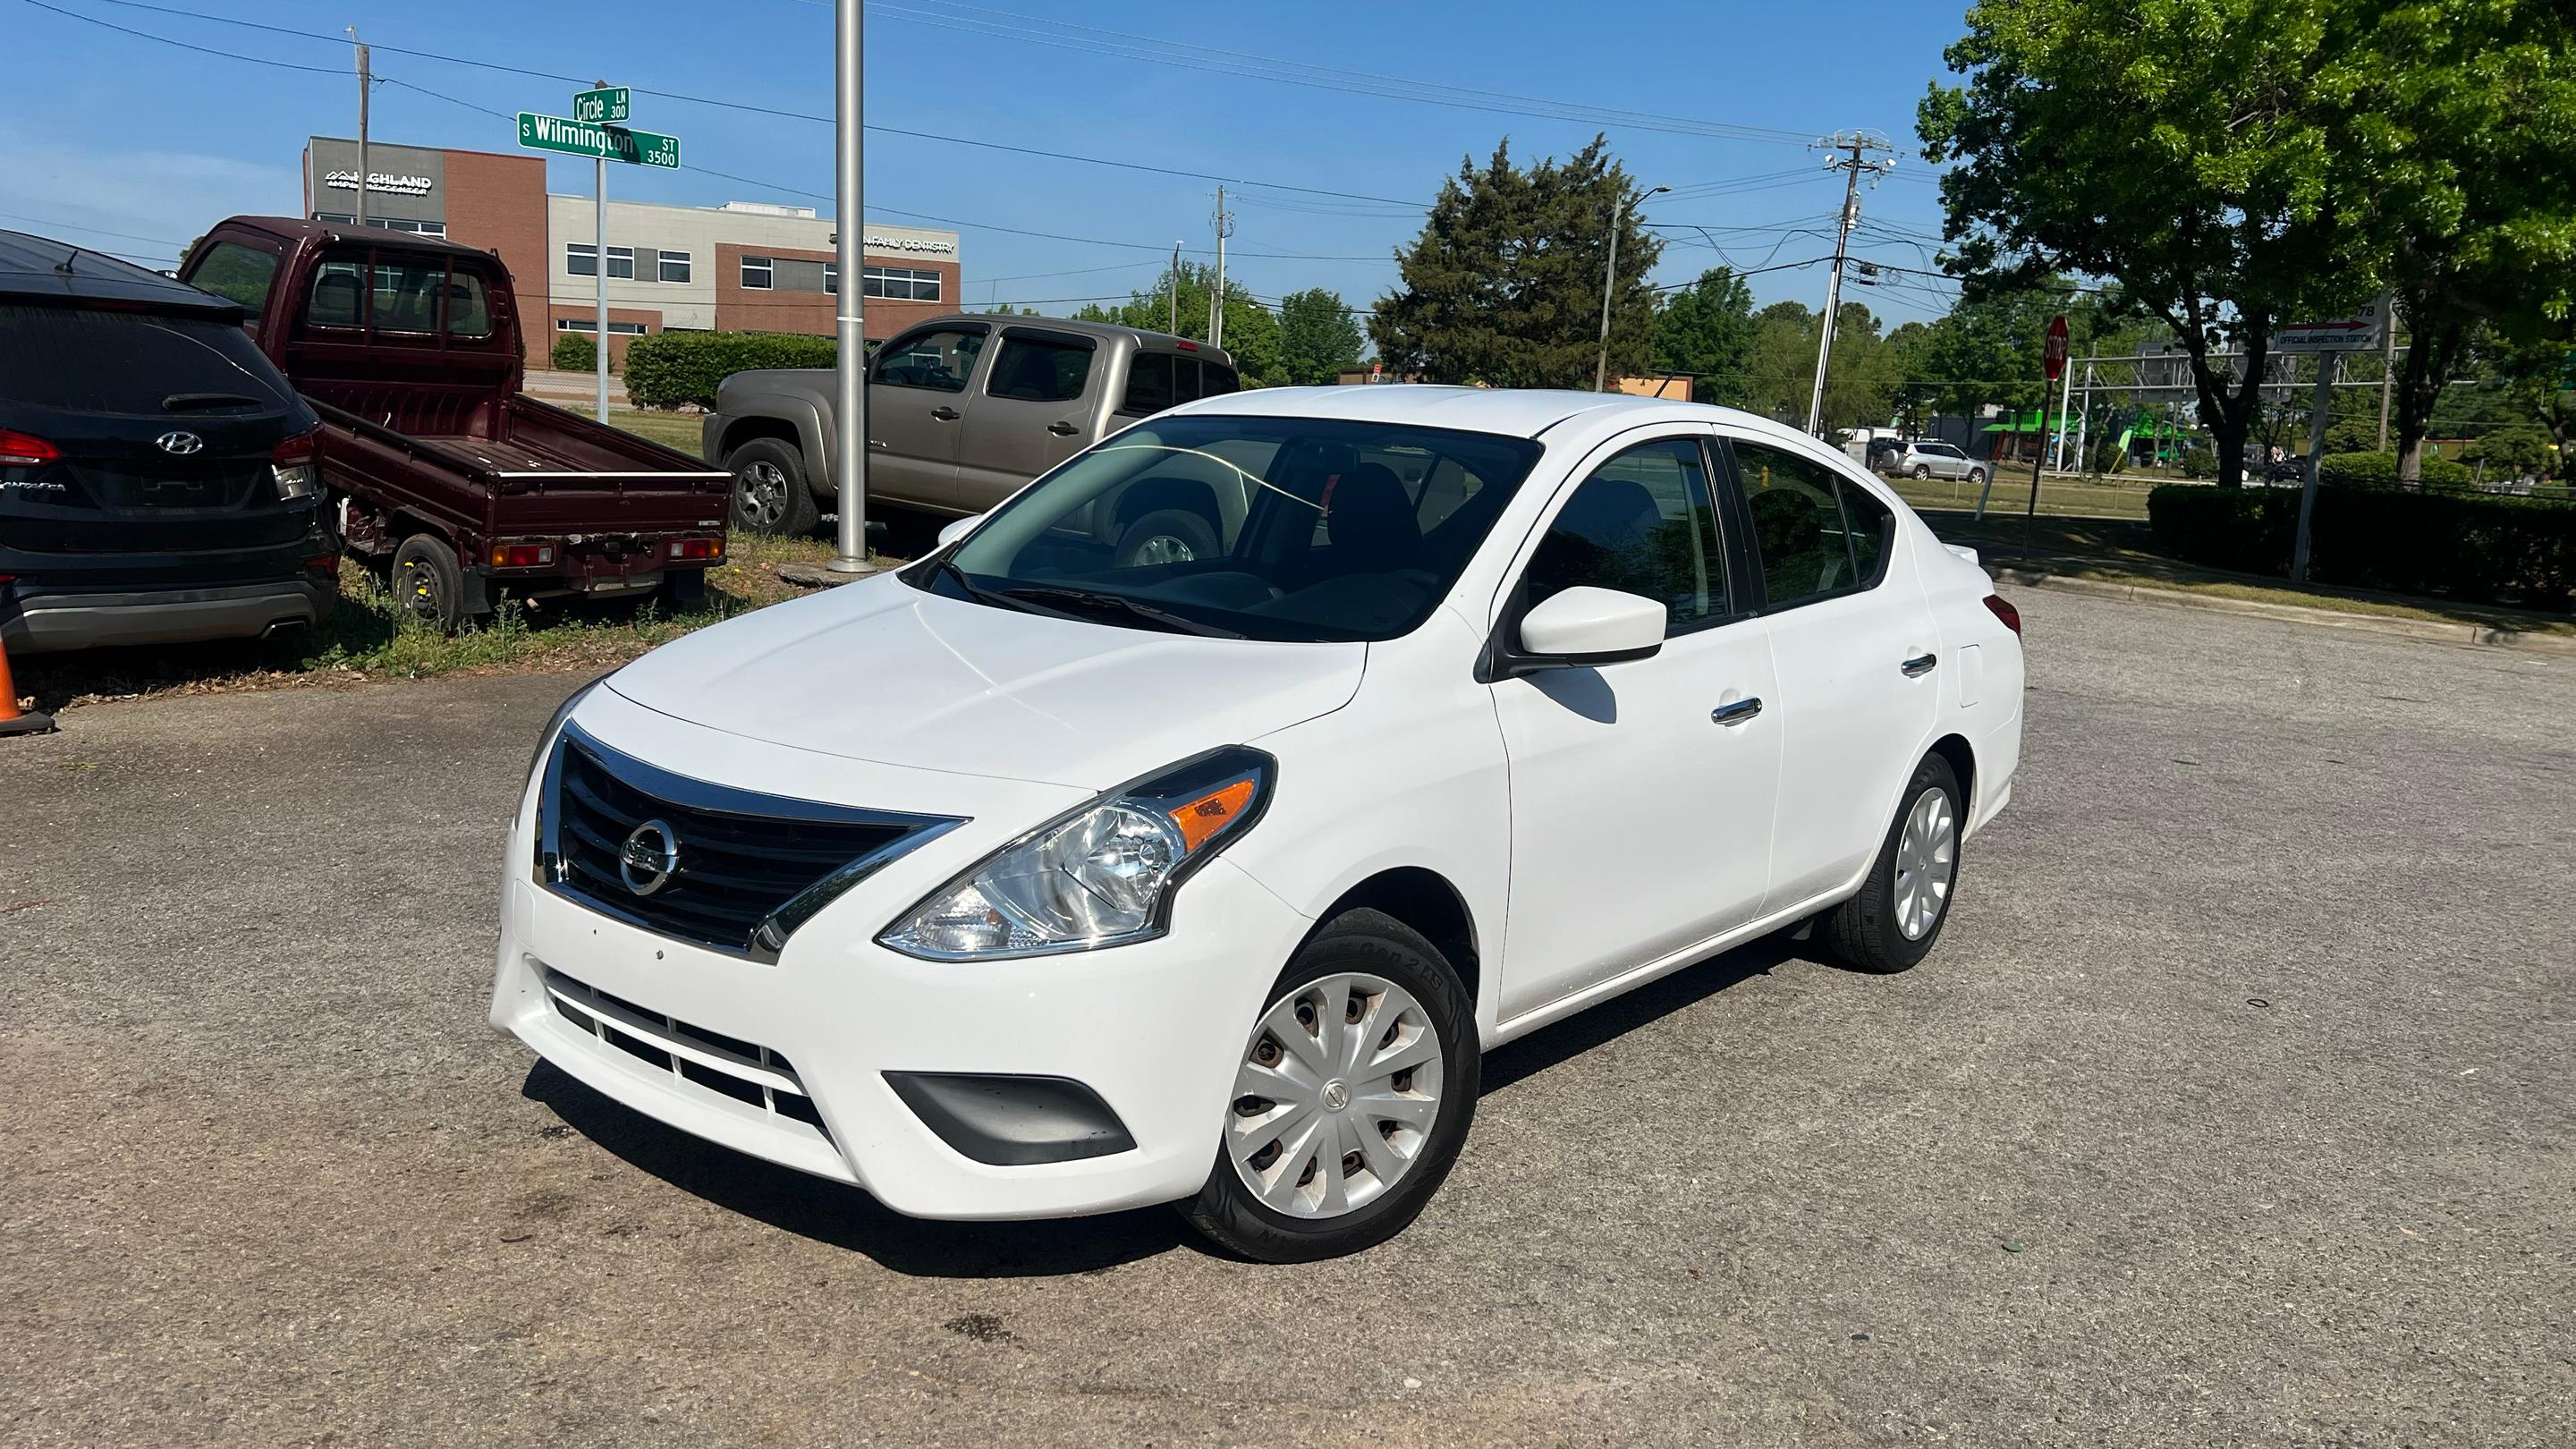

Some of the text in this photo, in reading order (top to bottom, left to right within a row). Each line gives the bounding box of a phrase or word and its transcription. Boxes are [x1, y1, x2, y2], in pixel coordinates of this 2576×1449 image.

[577, 90, 626, 121] Circle LN
[611, 106, 626, 119] 300
[522, 115, 675, 156] S Wilmington ST
[648, 150, 675, 166] 3500
[353, 171, 432, 188] HGHLAND
[872, 235, 903, 247] FAMILY
[905, 239, 954, 251] DENTISTRY
[2045, 335, 2067, 360] STOP
[2280, 335, 2372, 344] OFFICIAL INSPECTION STATION
[1360, 942, 1402, 962] Gen
